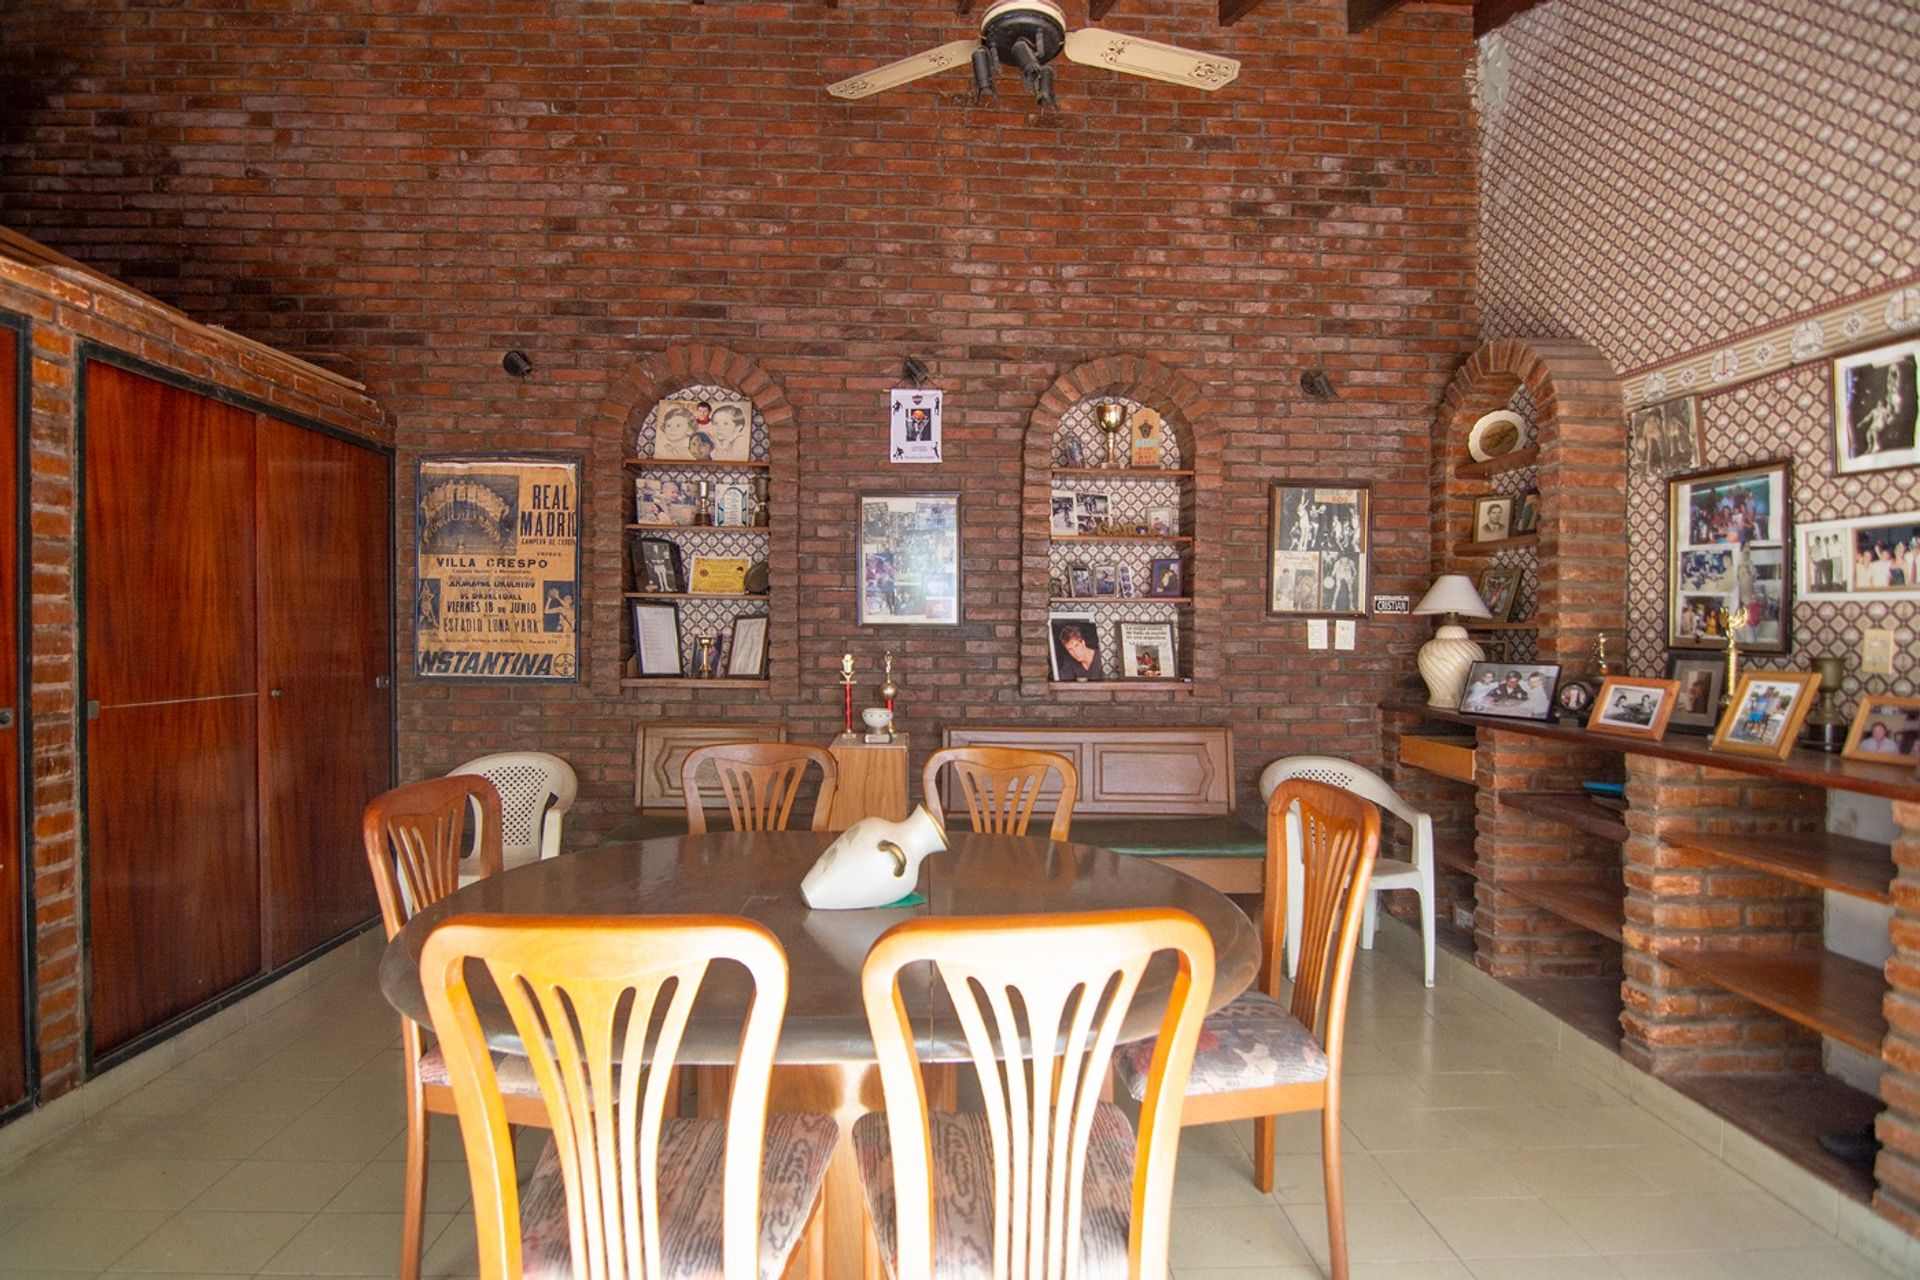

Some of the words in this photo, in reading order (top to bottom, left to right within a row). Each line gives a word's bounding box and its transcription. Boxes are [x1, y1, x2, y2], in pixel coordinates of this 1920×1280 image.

[532, 484, 569, 510] REAL
[436, 558, 476, 567] VILLA
[486, 558, 548, 569] CRESPO
[447, 601, 480, 613] VIERNES
[510, 602, 536, 614] JUNIO
[443, 618, 483, 632] ESTADIO
[488, 619, 510, 633] LUNA
[514, 619, 539, 633] PARK
[418, 650, 554, 675] NSTANTINA
